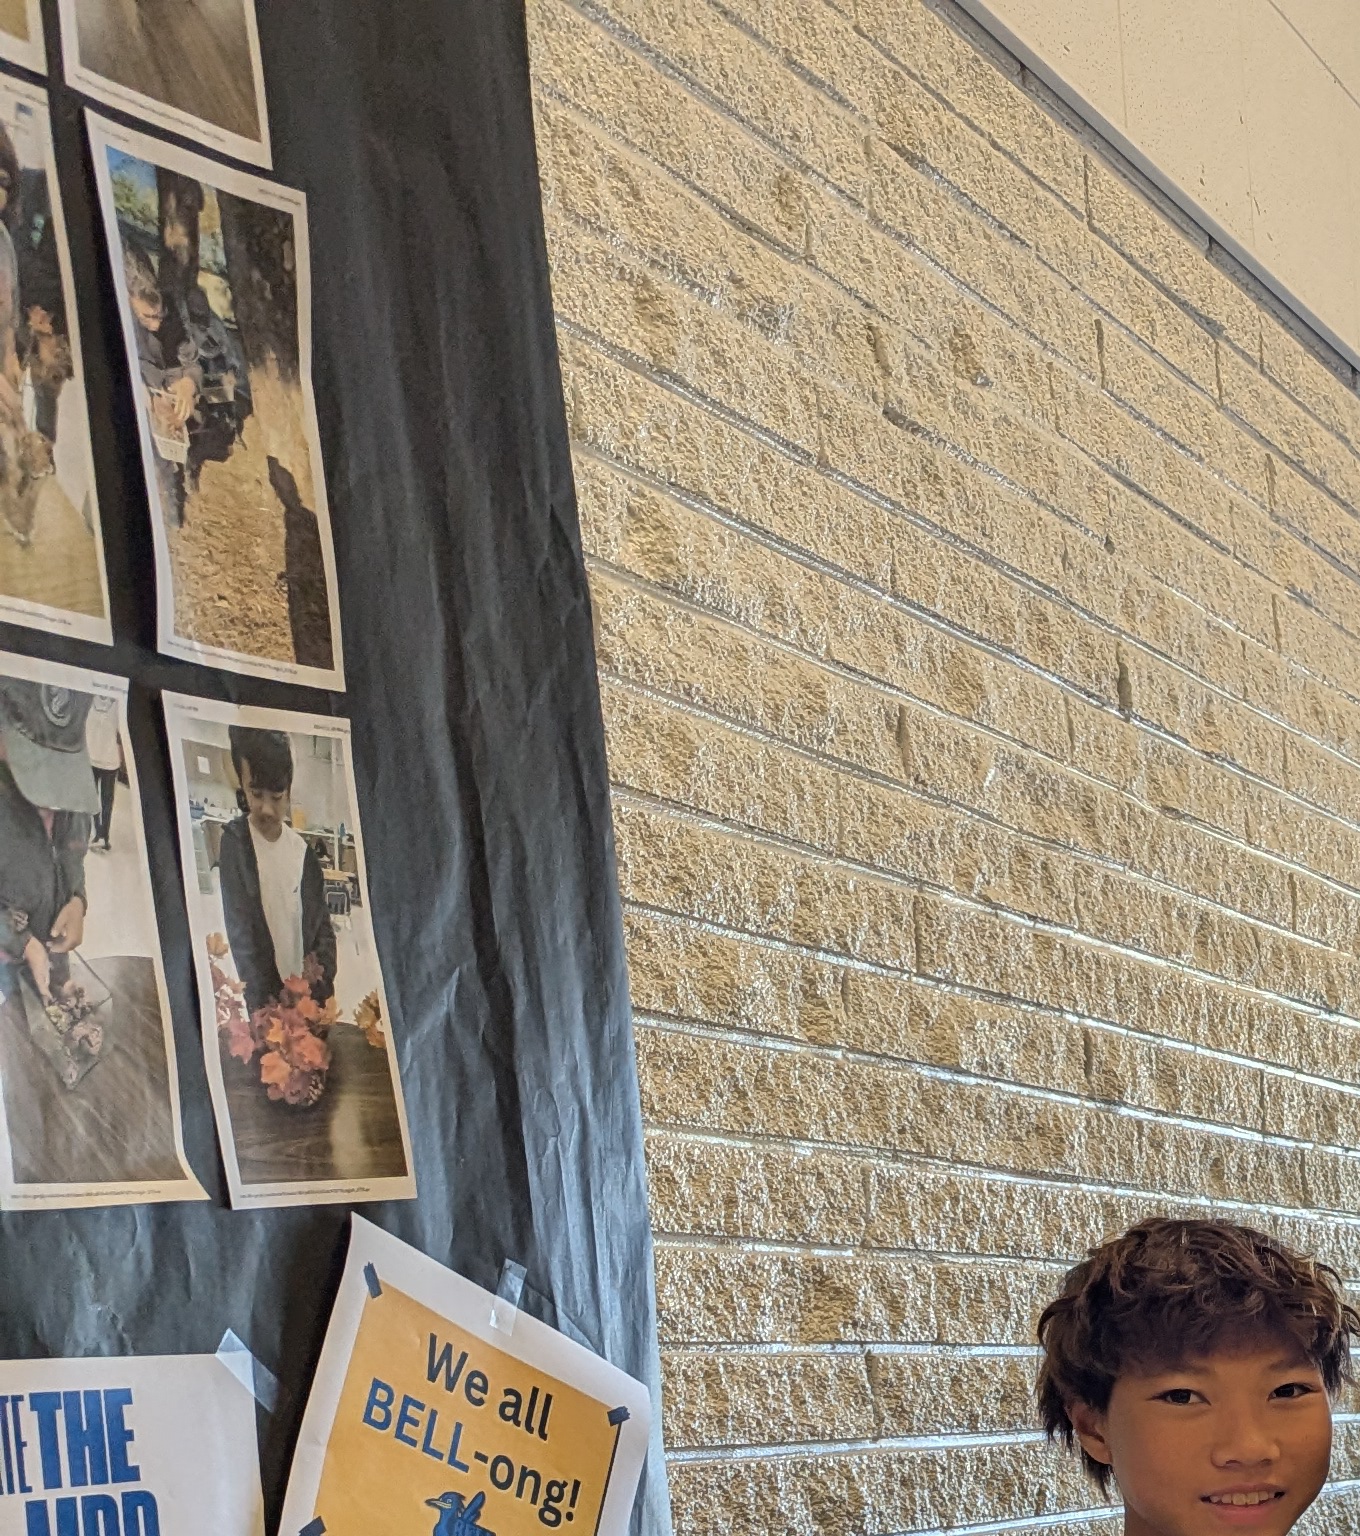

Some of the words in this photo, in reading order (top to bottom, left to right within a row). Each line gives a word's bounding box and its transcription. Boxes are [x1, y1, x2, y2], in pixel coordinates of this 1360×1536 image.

[29, 1388, 141, 1490] THE
[426, 1332, 490, 1407] We
[499, 1386, 553, 1442] all
[362, 1377, 582, 1528] BELL-ong!
